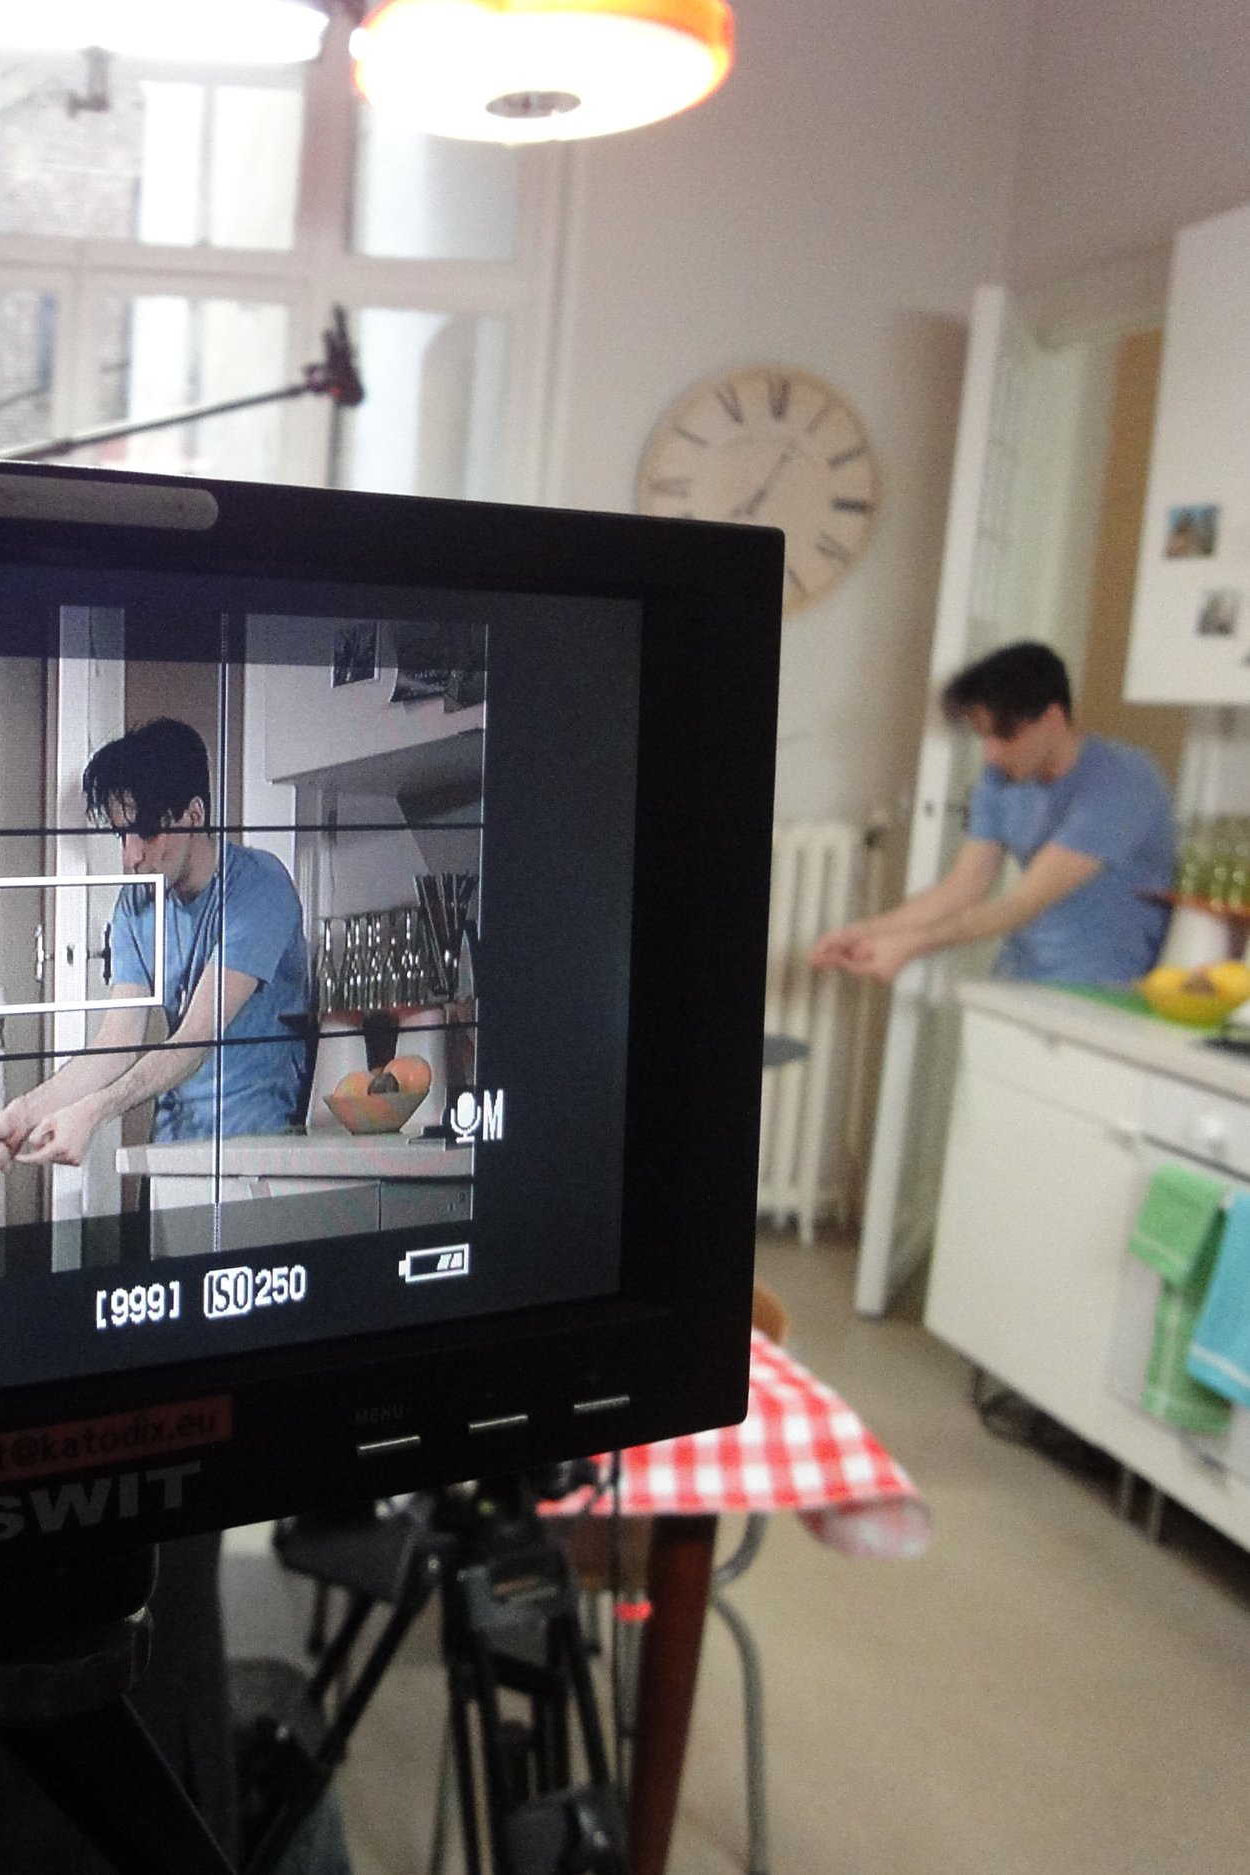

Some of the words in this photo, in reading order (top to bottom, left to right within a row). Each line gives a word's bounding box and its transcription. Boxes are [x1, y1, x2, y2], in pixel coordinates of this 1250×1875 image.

[482, 1088, 505, 1142] M
[95, 1280, 180, 1330] [999]
[354, 1402, 405, 1427] MENU
